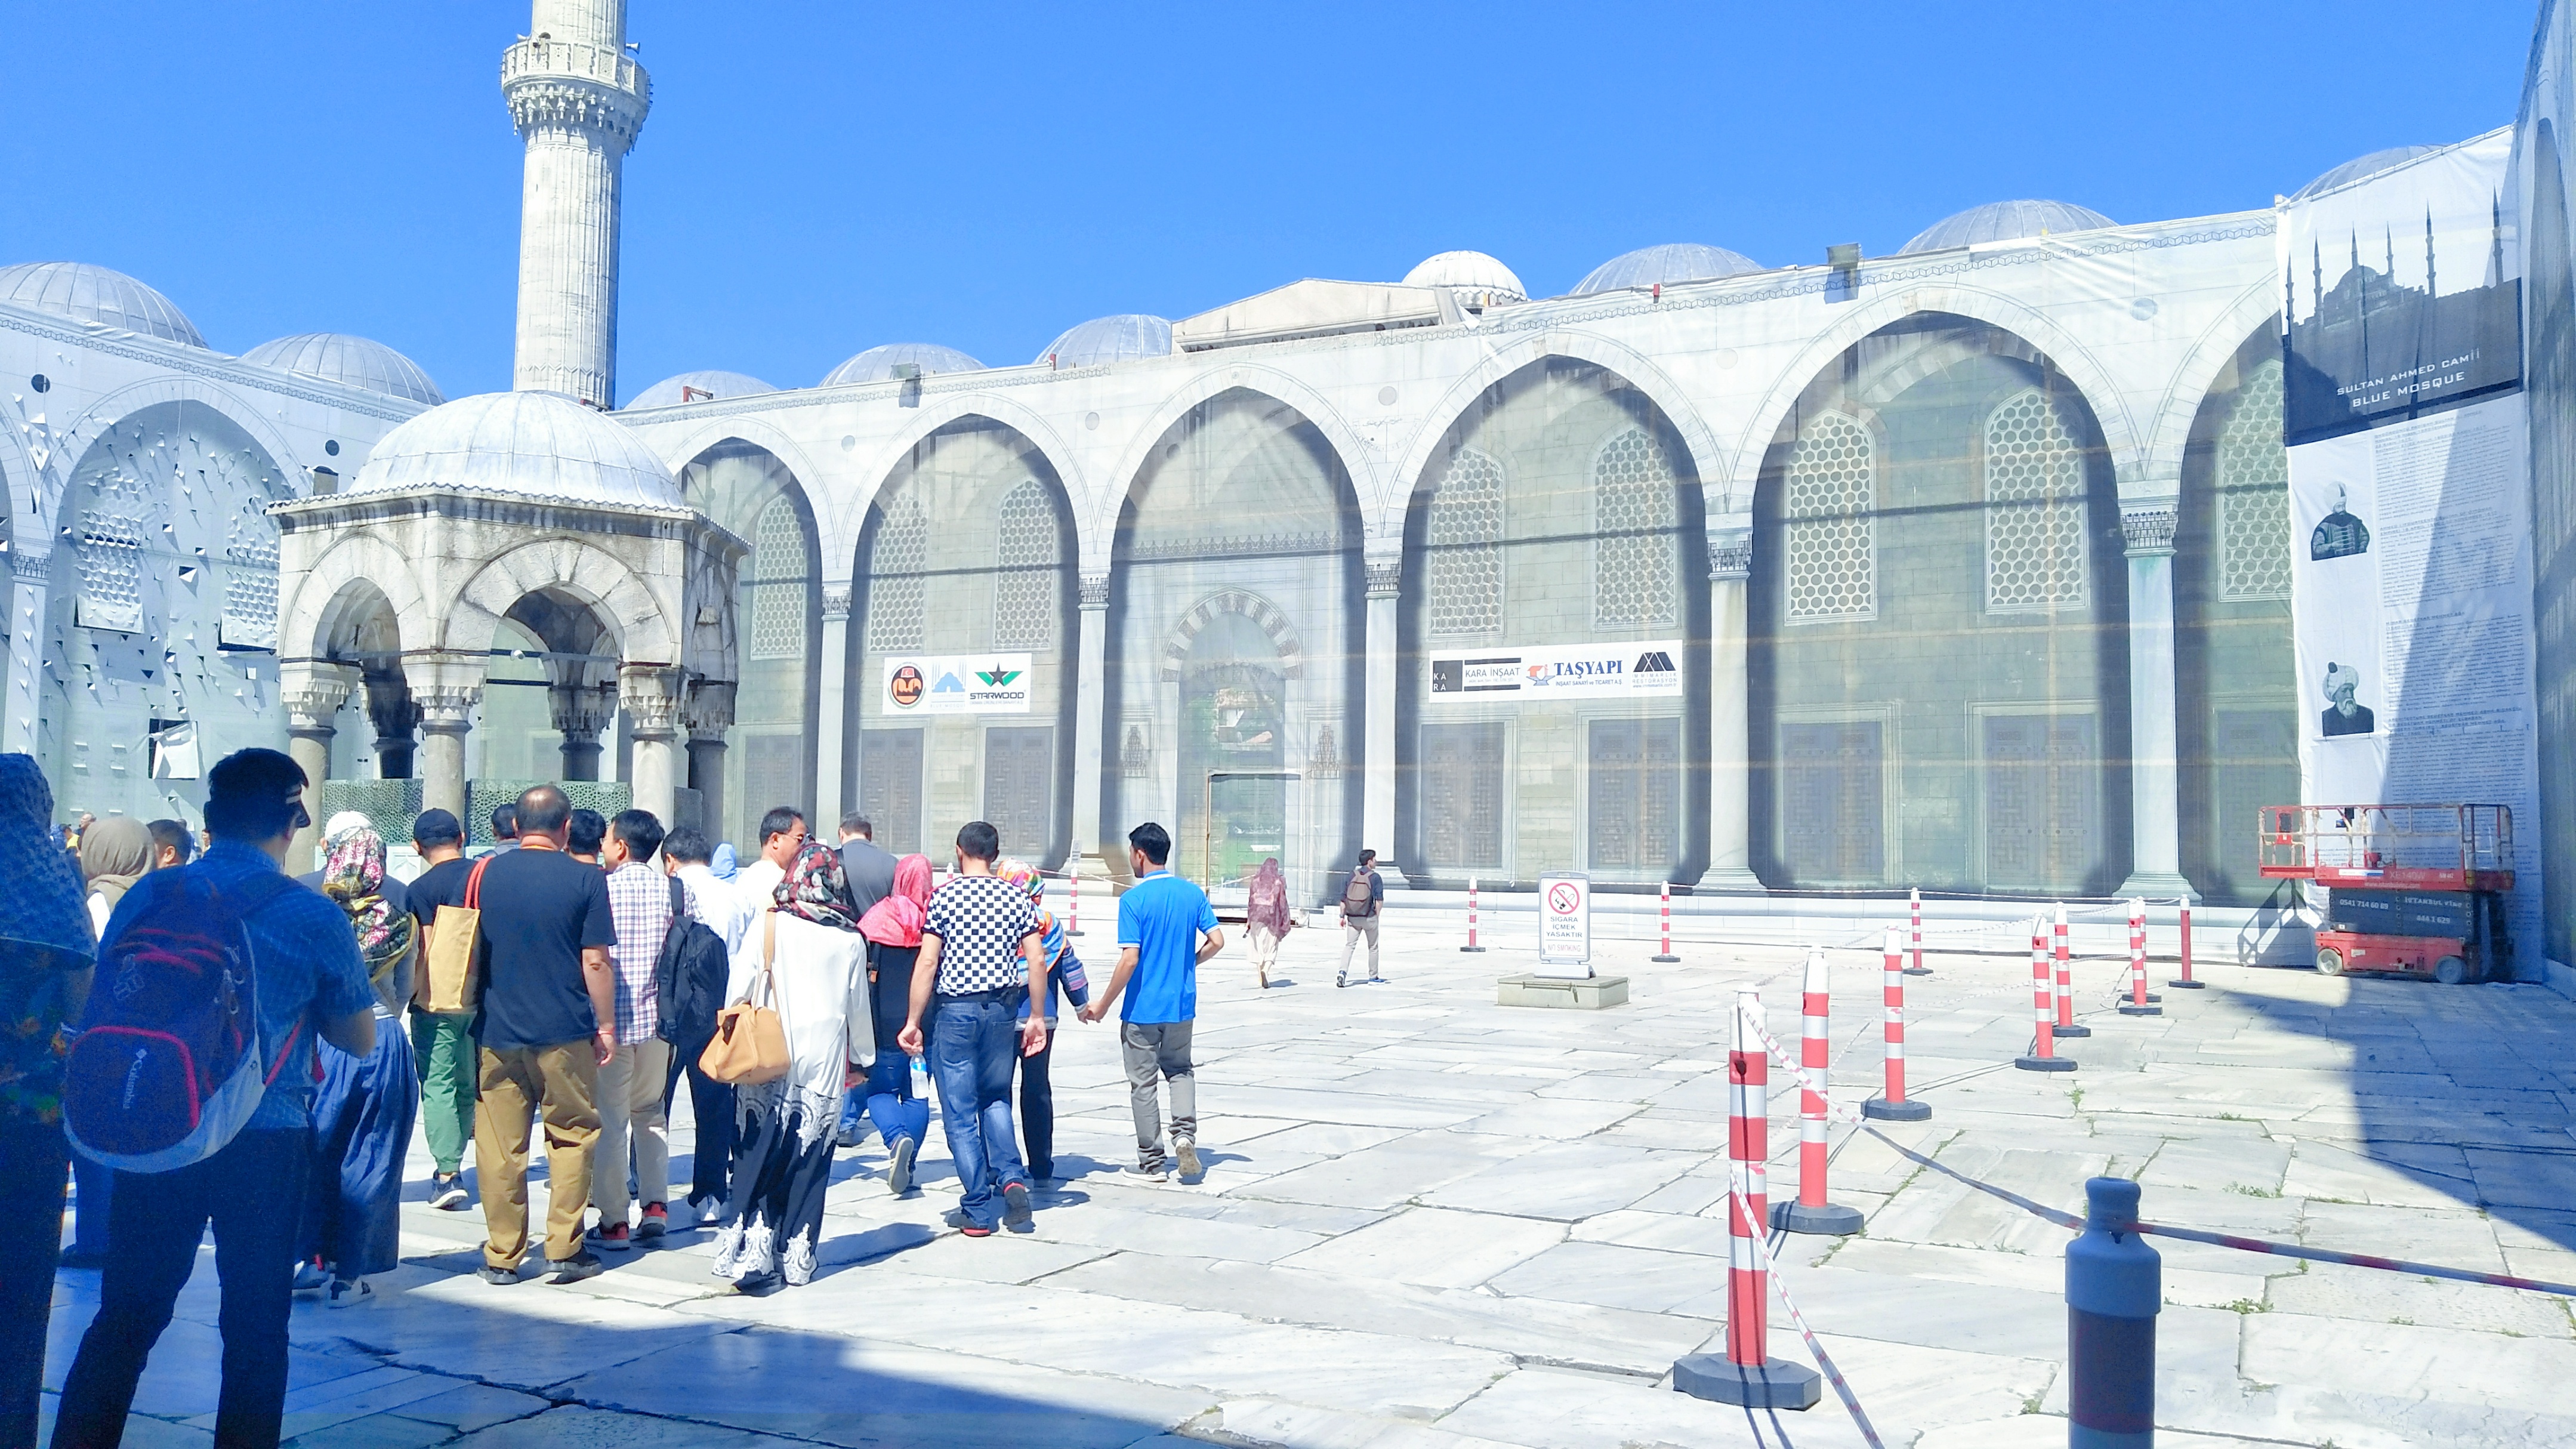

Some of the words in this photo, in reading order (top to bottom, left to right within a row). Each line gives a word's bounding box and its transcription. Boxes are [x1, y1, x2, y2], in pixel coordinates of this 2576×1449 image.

[2337, 377, 2384, 396] SULTAN
[2390, 363, 2435, 382] AHMED
[2353, 390, 2391, 408] BLUE
[2398, 371, 2465, 396] MOSQUE
[1466, 669, 1487, 678] KARA
[1491, 667, 1521, 679] İNŞAAT
[1554, 660, 1623, 679] TAŞYAPI
